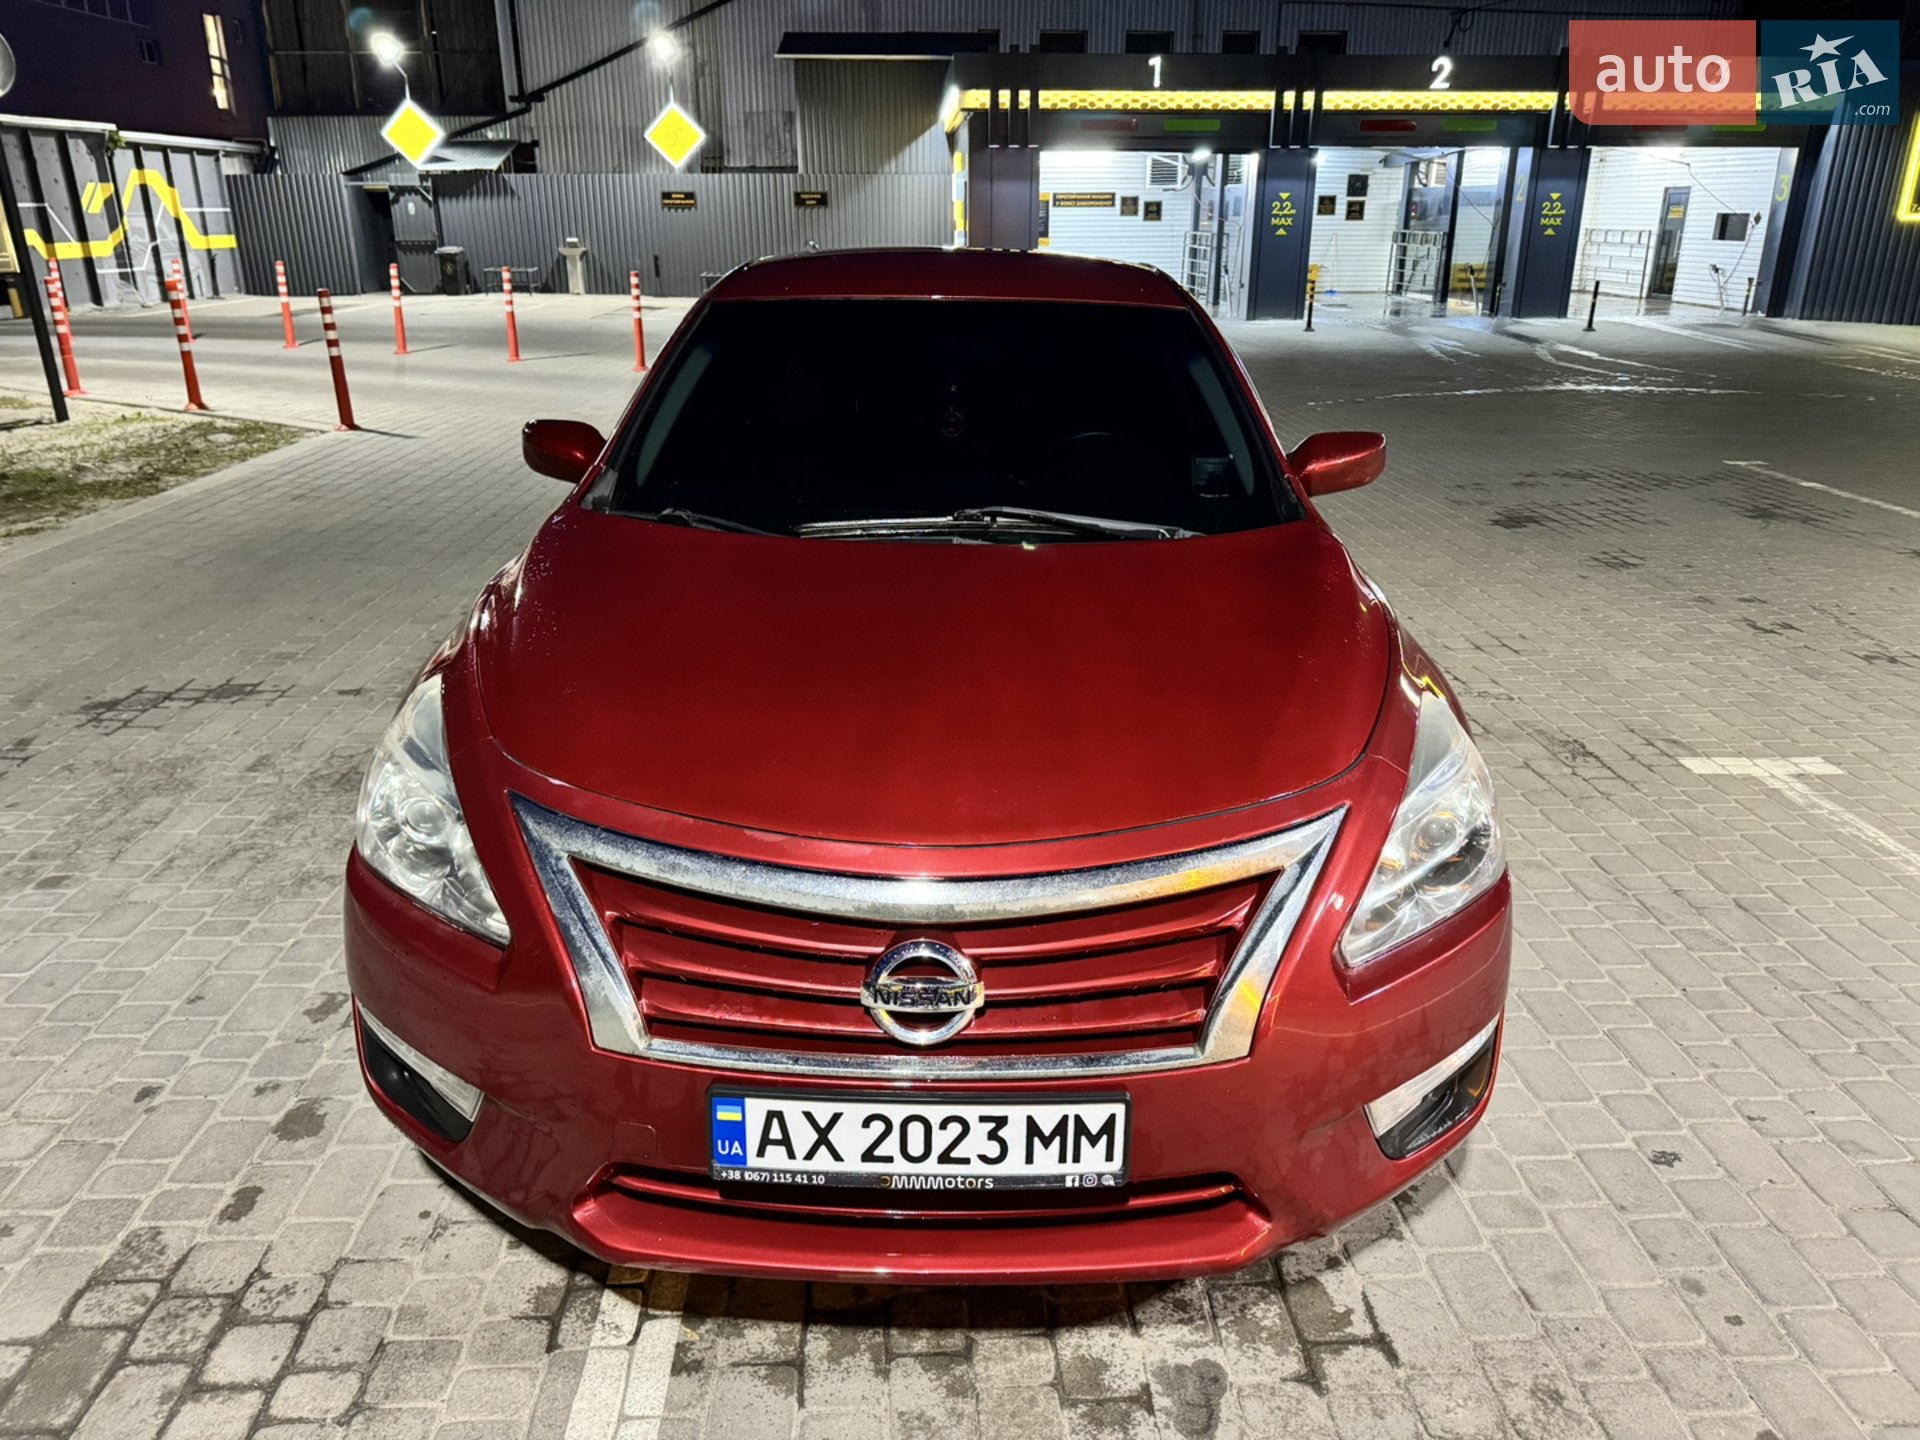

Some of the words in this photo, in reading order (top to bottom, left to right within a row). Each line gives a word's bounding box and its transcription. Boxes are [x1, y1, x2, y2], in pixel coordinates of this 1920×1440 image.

[1148, 55, 1162, 88] 1
[1429, 56, 1453, 89] 2
[1775, 175, 1790, 202] 3
[873, 986, 971, 1008] NISSAN
[717, 1139, 744, 1157] UA
[756, 1109, 845, 1163] AX
[860, 1113, 1009, 1165] 2023
[1025, 1113, 1117, 1165] MM
[721, 1170, 741, 1180] +38
[773, 1173, 793, 1183] 115
[795, 1174, 809, 1184] 41
[811, 1175, 825, 1185] 10
